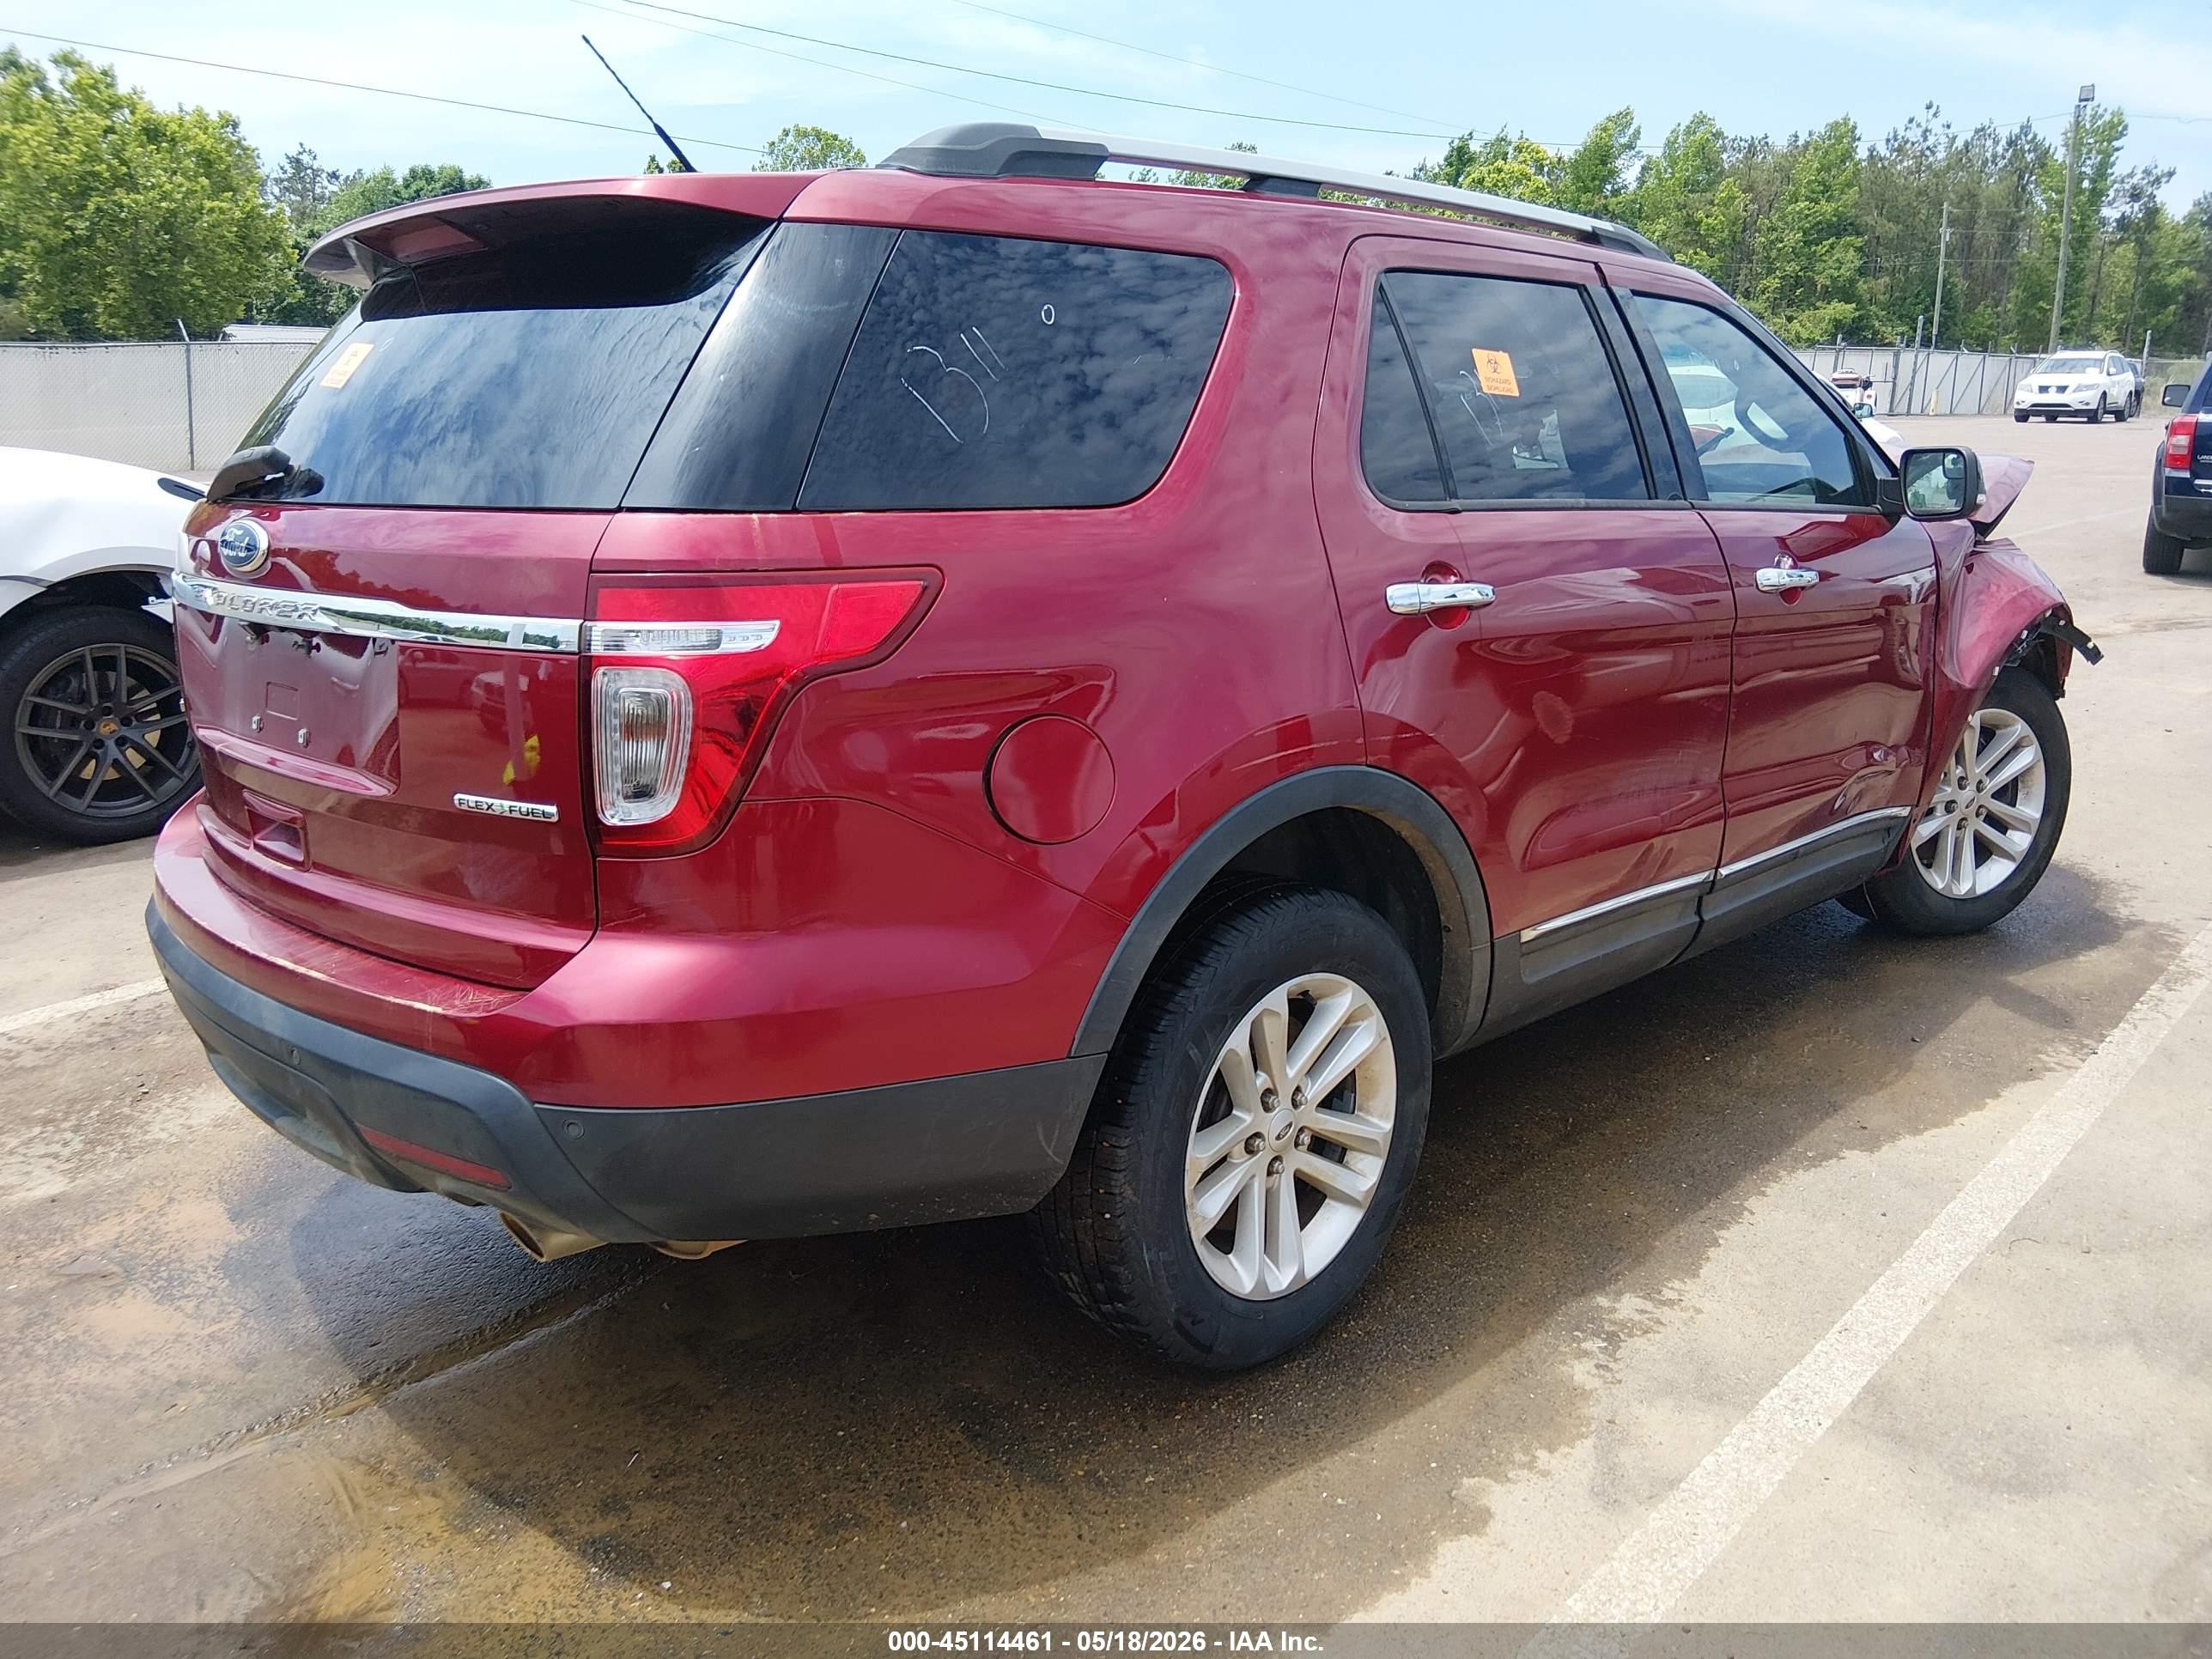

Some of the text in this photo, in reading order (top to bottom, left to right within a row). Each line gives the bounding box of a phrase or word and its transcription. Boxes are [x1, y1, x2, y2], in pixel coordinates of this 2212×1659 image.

[220, 524, 251, 558] Ford
[458, 797, 556, 819] FLEX FUEL
